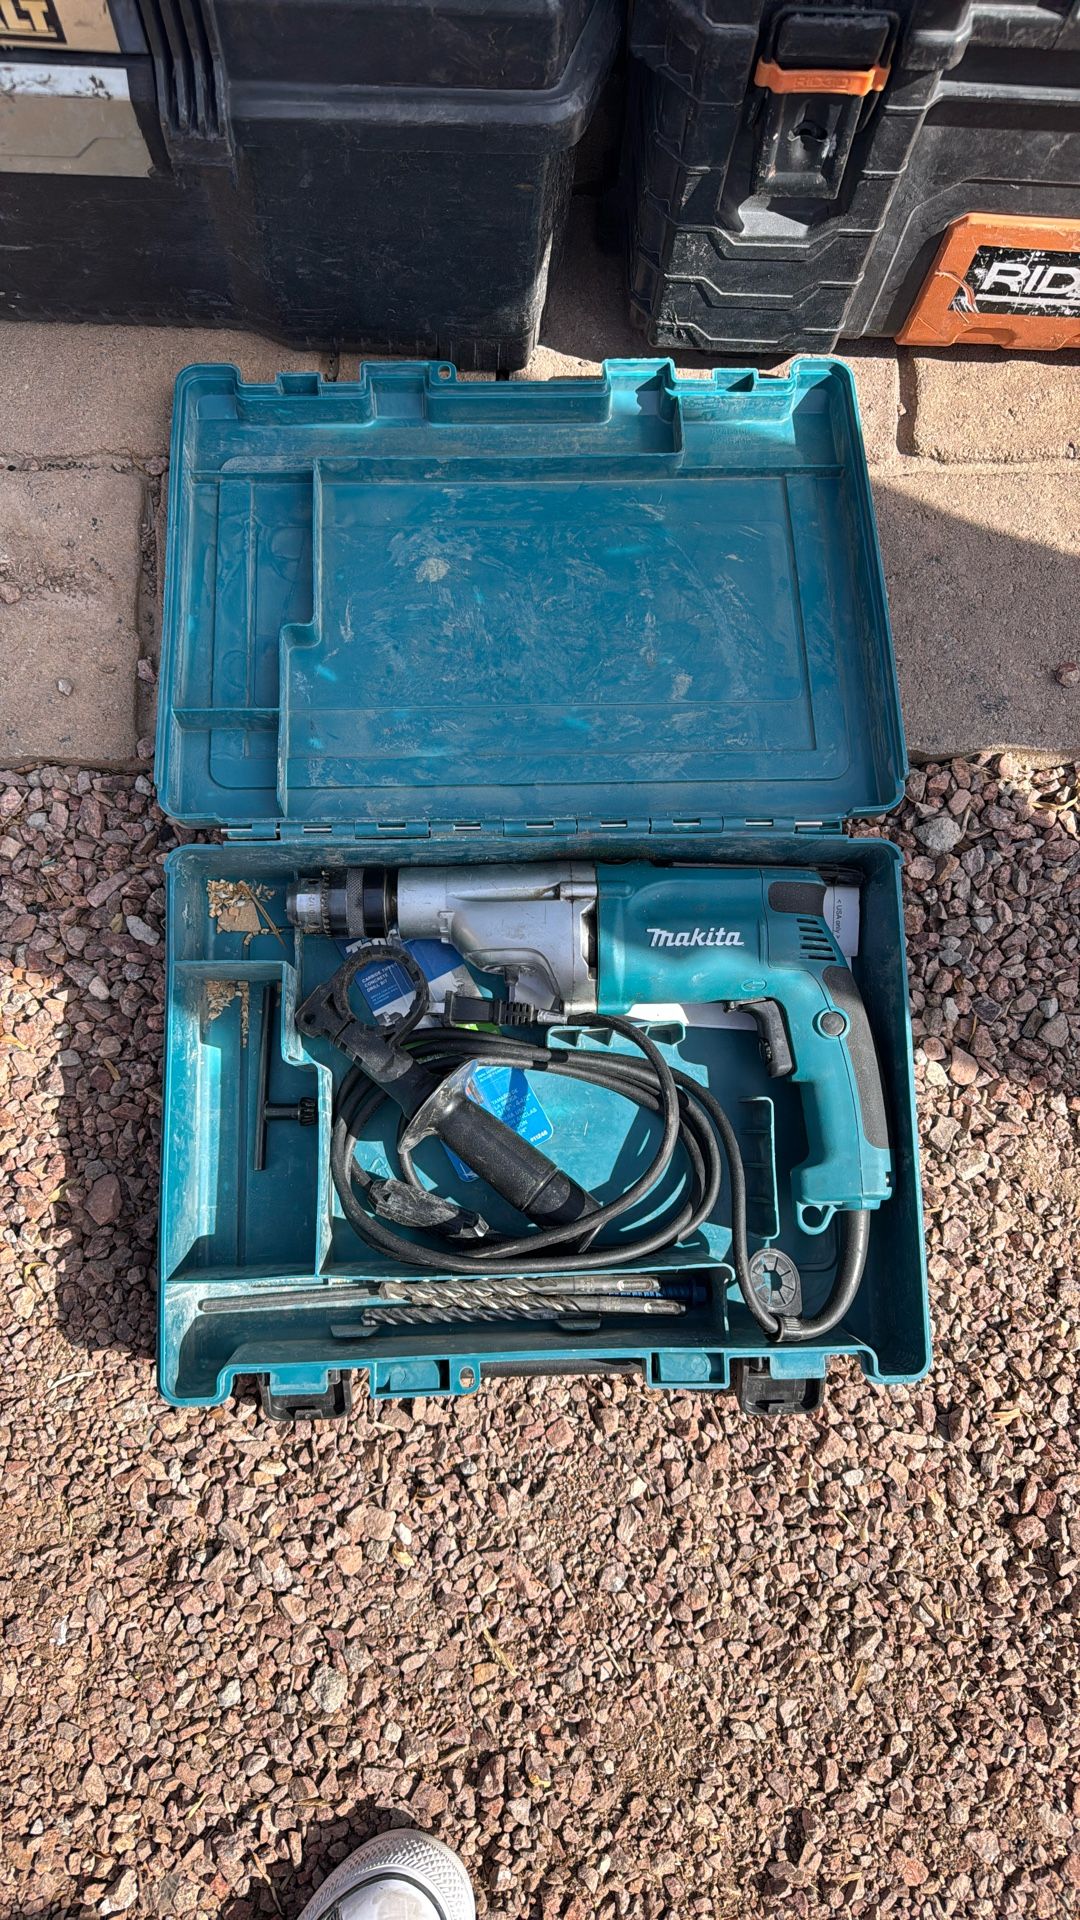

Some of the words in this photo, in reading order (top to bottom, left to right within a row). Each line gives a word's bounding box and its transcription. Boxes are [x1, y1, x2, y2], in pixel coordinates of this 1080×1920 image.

[0, 0, 50, 33] LT
[980, 262, 1080, 294] RID
[361, 970, 381, 983] CARBIDE
[364, 973, 388, 988] CONCRETE
[366, 983, 380, 992] DRILL
